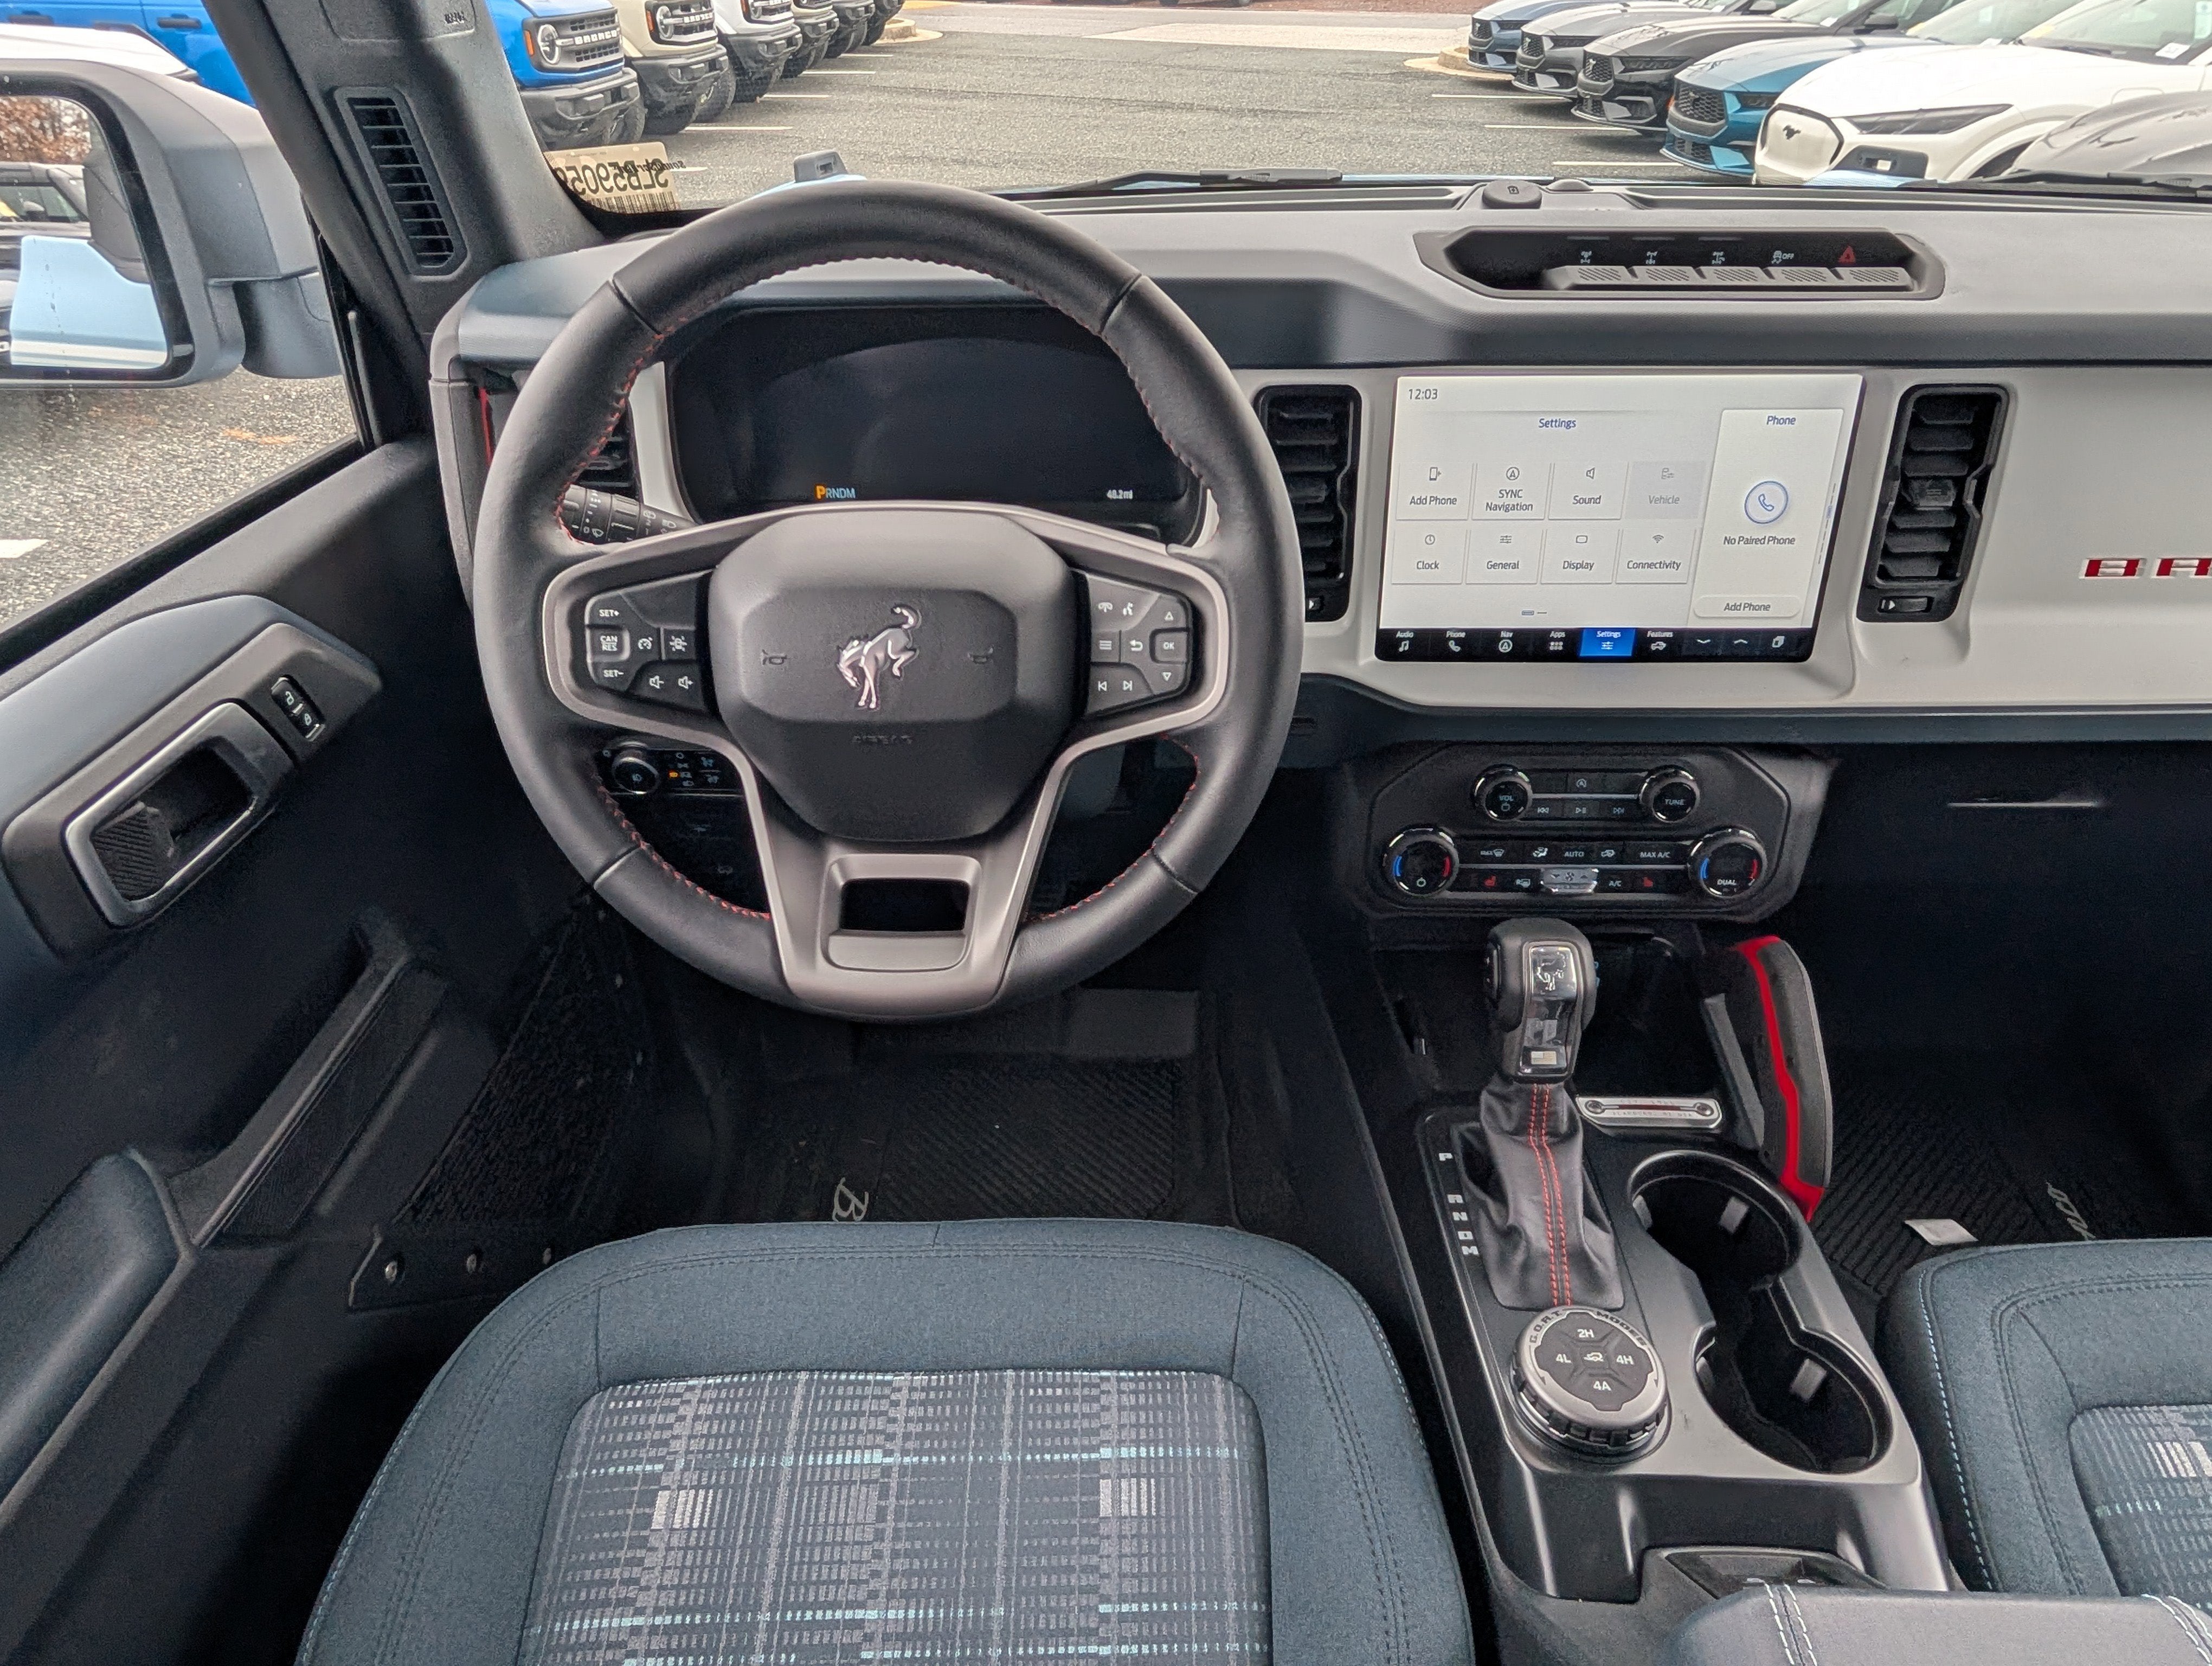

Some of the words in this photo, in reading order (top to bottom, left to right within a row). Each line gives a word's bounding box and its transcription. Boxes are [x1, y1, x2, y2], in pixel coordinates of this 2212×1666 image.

[575, 30, 618, 44] BRONCO
[1409, 388, 1438, 400] 12:03
[1539, 418, 1576, 429] Settings
[1766, 415, 1796, 425] Phone
[1499, 489, 1523, 498] SYNC
[1410, 496, 1427, 505] Add
[1429, 496, 1457, 505] Phone
[1573, 495, 1602, 504] Sound
[1649, 495, 1680, 504] Vehicle
[1486, 502, 1533, 512] Navigation
[1724, 536, 1736, 544] No
[1738, 536, 1766, 544] Paired
[1767, 536, 1795, 544] Phone
[1416, 560, 1439, 569] Clock
[1487, 560, 1519, 569] General
[1562, 560, 1594, 571] Display
[1627, 560, 1681, 570] Connectivity
[1724, 603, 1741, 611] Add
[1742, 603, 1770, 611] Phone
[1163, 642, 1175, 650] OK
[1439, 1152, 1453, 1161] P
[1452, 1212, 1468, 1221] N
[1462, 1246, 1479, 1256] M
[1597, 1311, 1647, 1346] MODES
[1577, 1329, 1594, 1338] 2H
[1555, 1354, 1572, 1363] 4L
[1616, 1355, 1635, 1365] 4H
[1593, 1381, 1611, 1391] 4A
